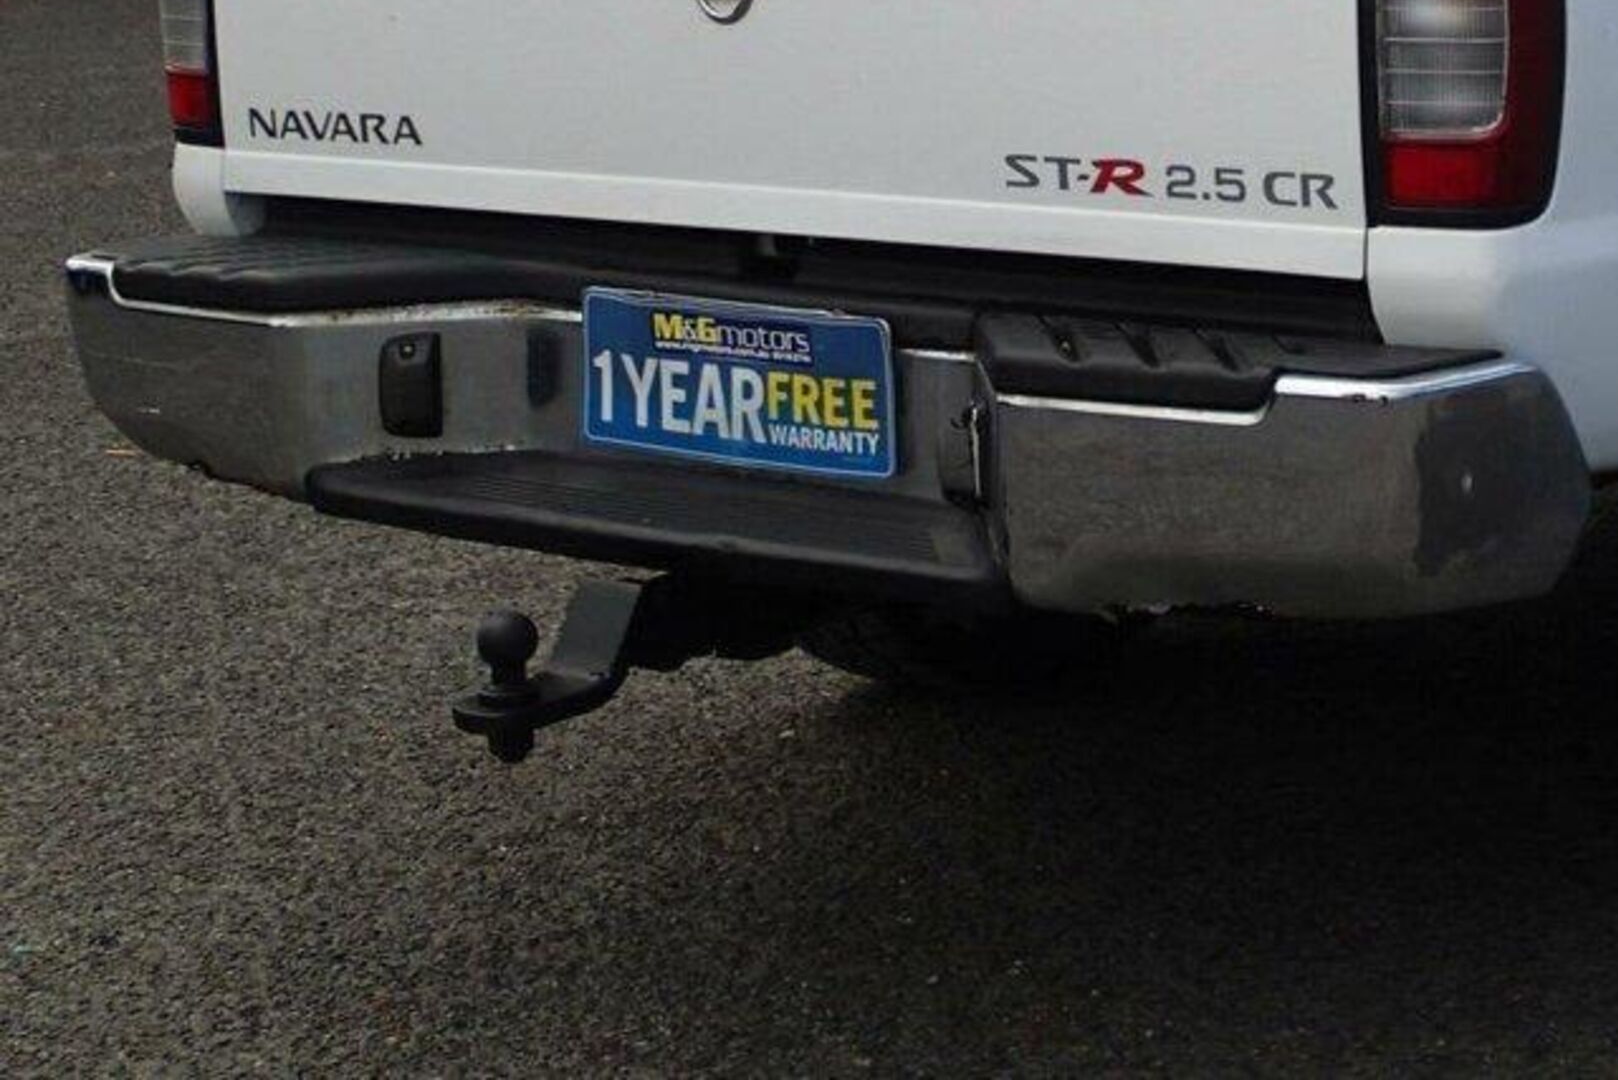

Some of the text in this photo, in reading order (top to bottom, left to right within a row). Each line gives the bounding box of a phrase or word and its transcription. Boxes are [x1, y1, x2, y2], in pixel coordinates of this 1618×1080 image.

[247, 107, 423, 146] NAVARA
[1004, 153, 1339, 210] ST-R 2.5 CR
[622, 354, 767, 444] YEAR
[767, 371, 880, 430] FREE
[769, 422, 881, 456] WARRANTY
